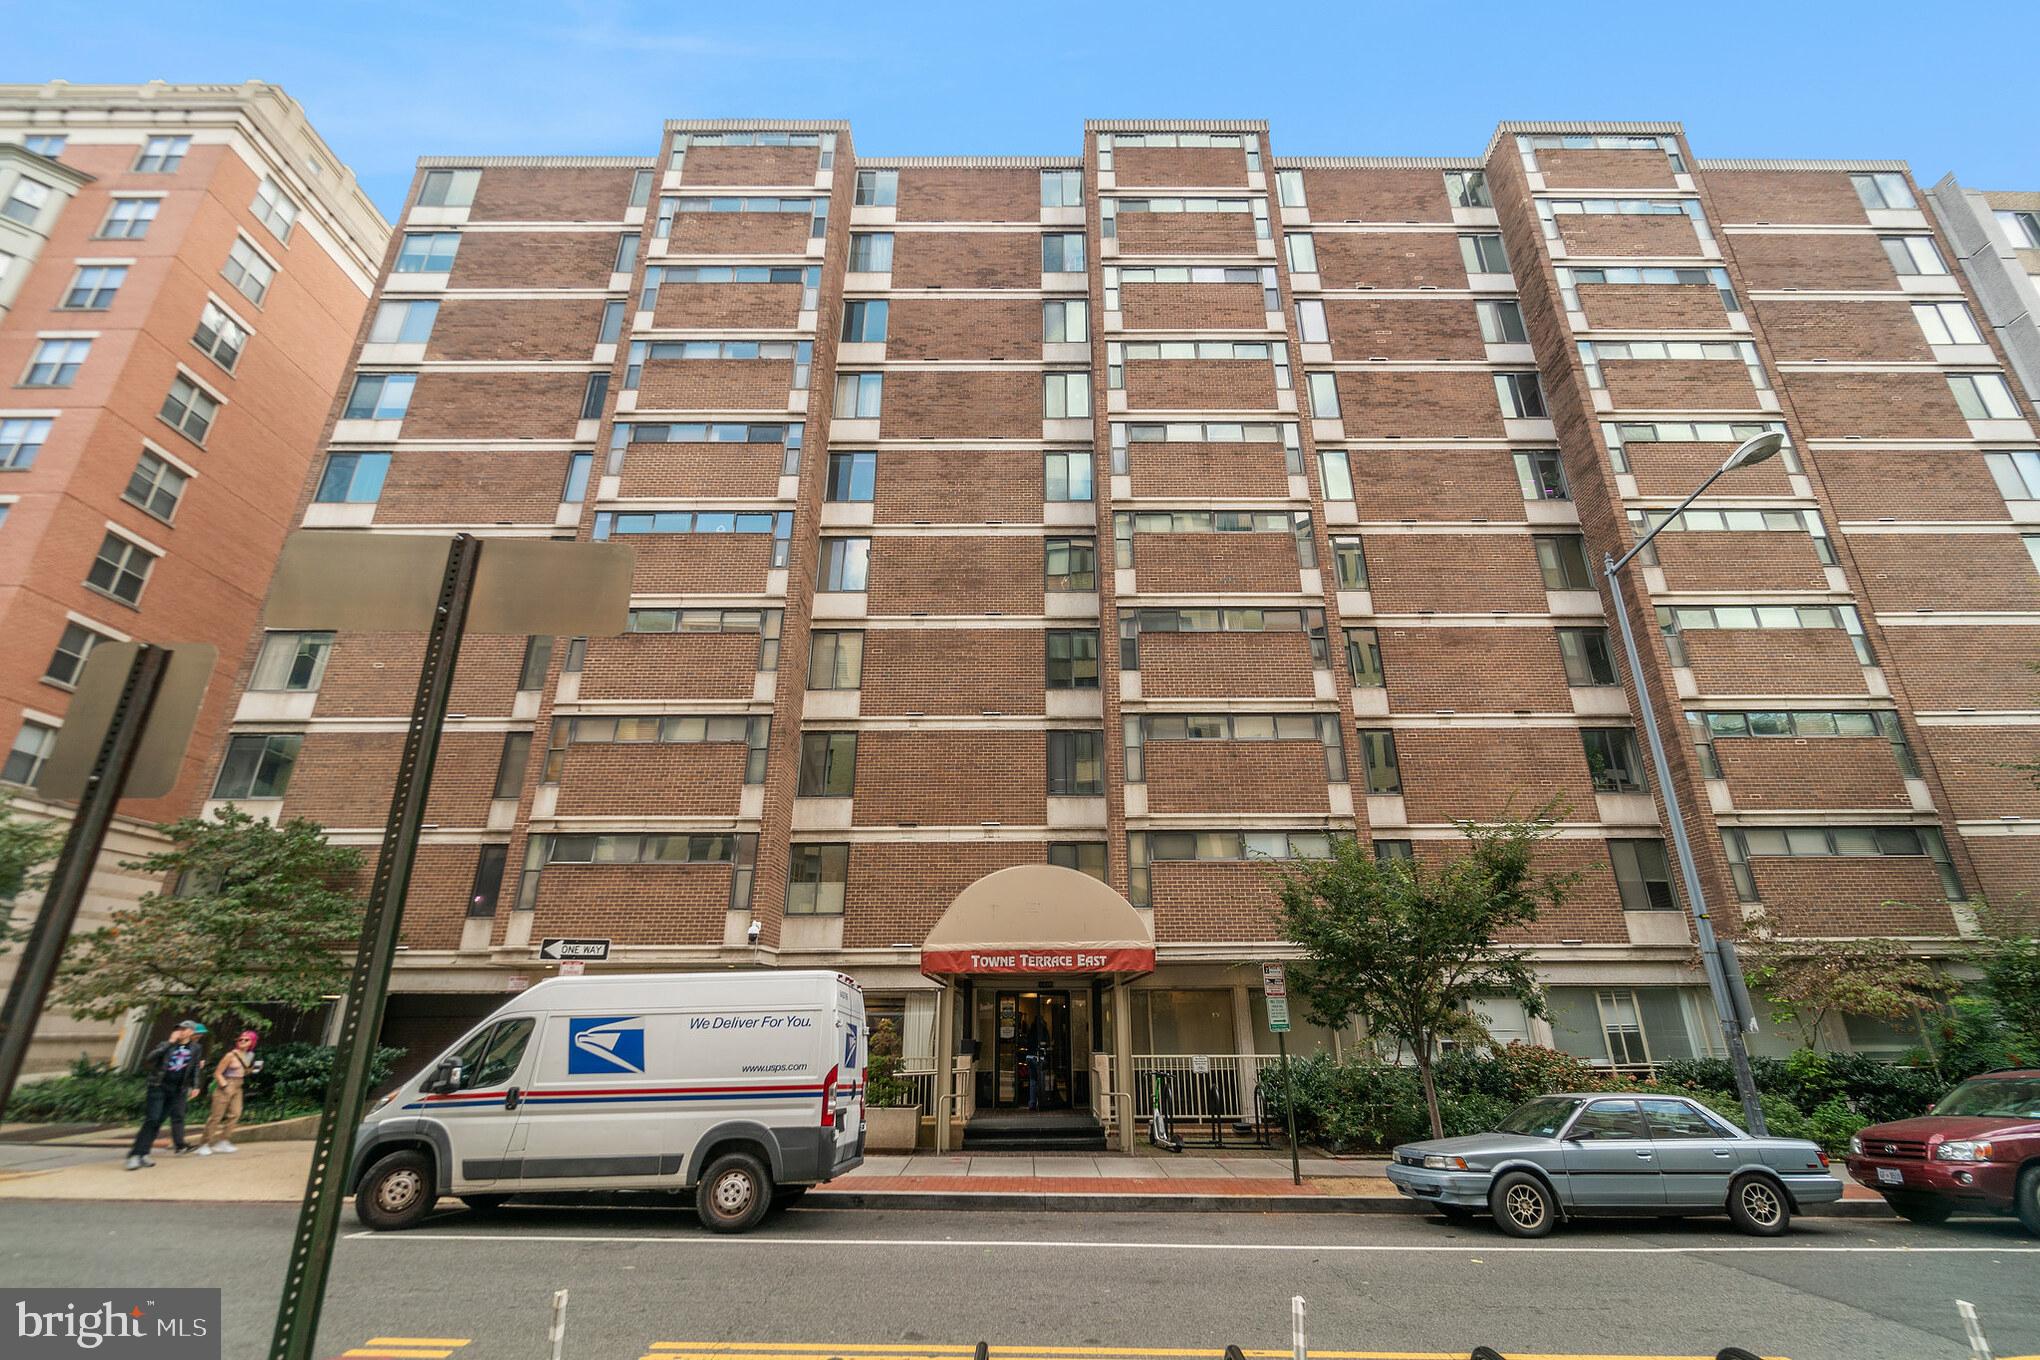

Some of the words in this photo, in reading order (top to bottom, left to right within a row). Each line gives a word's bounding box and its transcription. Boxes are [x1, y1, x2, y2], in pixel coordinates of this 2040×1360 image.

[561, 945, 580, 954] ONE
[583, 945, 603, 954] WAY
[971, 955, 1016, 968] TOWNE
[1020, 954, 1073, 967] TERRACE
[1077, 954, 1107, 967] EAST
[690, 1017, 710, 1029] We
[712, 1016, 760, 1029] Deliver
[761, 1016, 784, 1028] For
[786, 1015, 811, 1028] You.
[742, 1063, 808, 1073] www.usps.com
